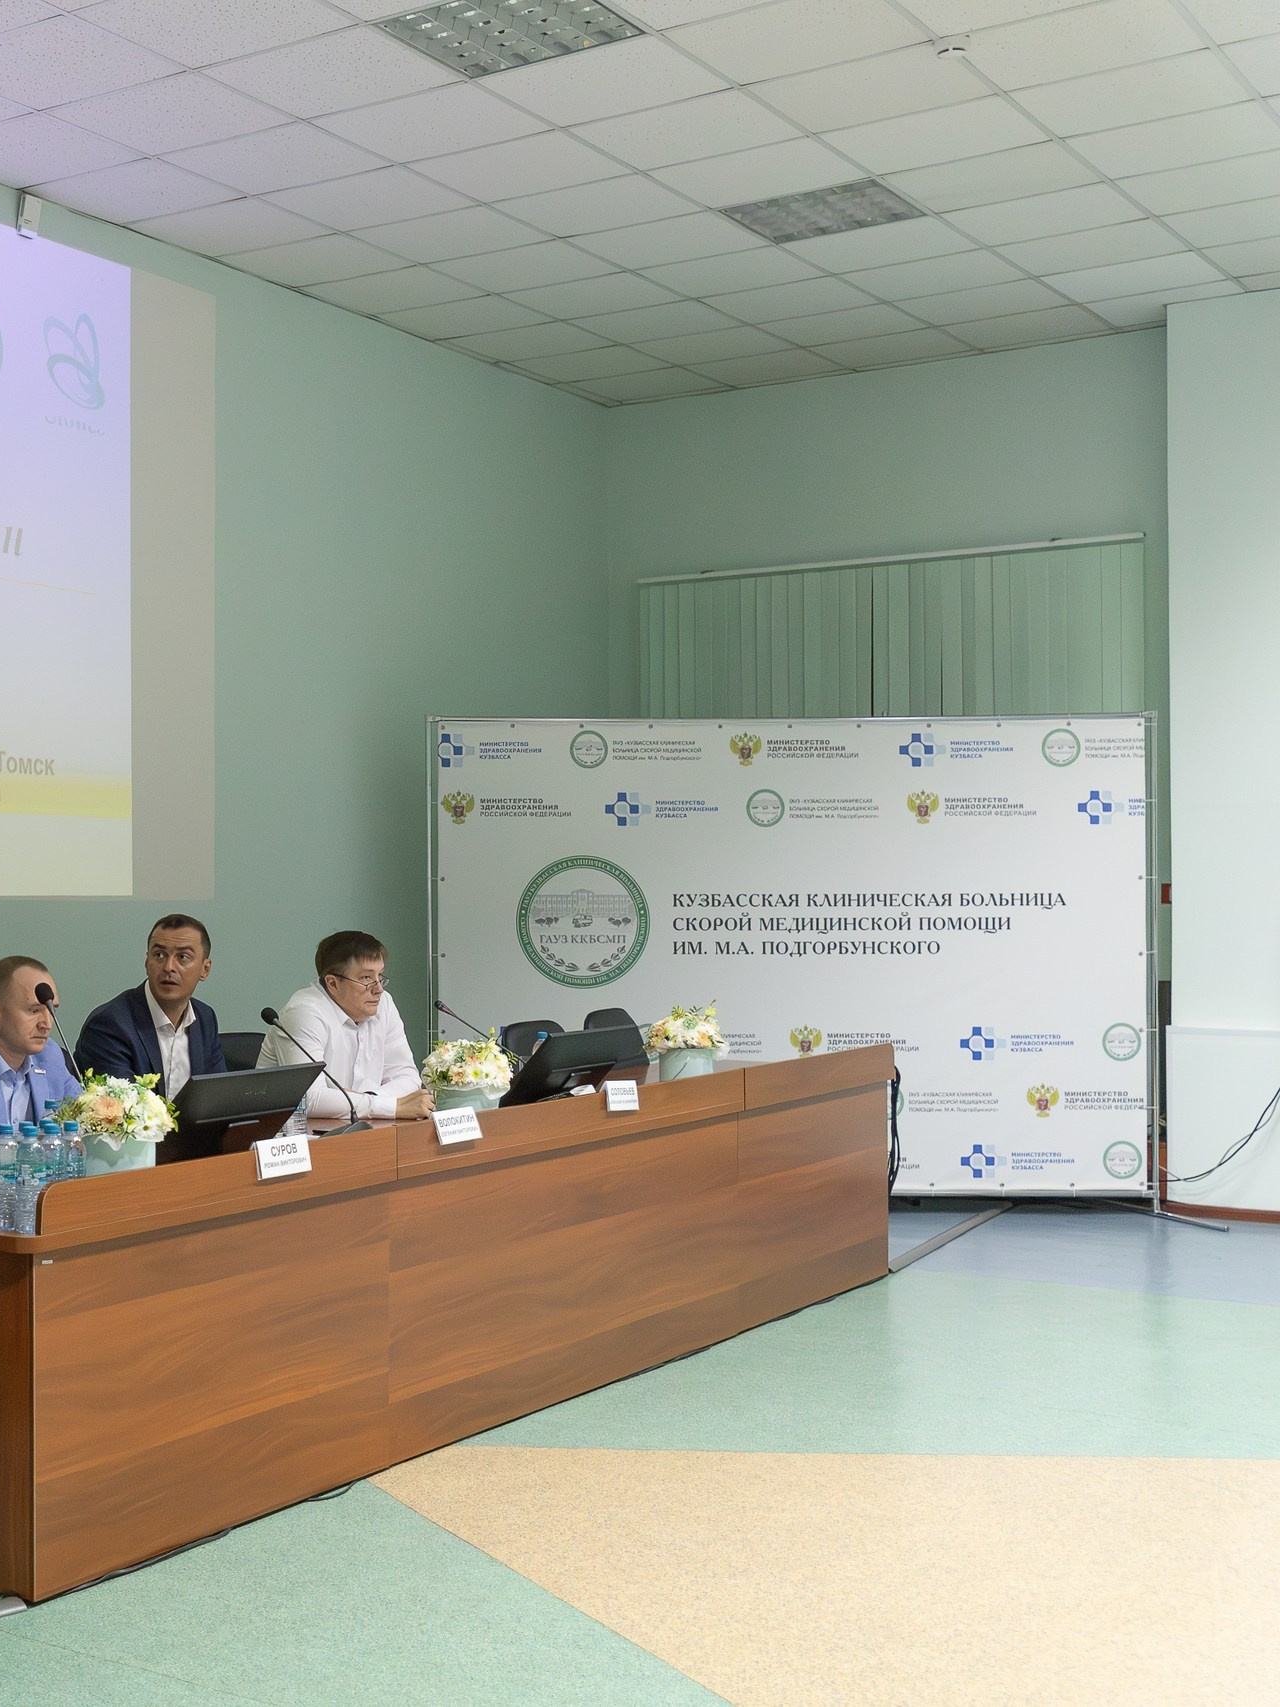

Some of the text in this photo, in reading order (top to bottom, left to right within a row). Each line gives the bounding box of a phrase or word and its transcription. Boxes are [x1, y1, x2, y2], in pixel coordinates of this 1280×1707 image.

[672, 892, 1067, 910] КУЗБАССКАЯ КЛИНИЧЕСКАЯ БОЛЬНИЦА
[672, 911, 1011, 935] СКОРОЙ МЕДИЦИНСКОЙ ПОМОЩИ
[540, 934, 627, 944] ГАУЗ ККБСМП
[672, 941, 941, 958] ИМ. М.А. ПОДГОРБУНСКОГО
[270, 1143, 298, 1157] СУРОВ
